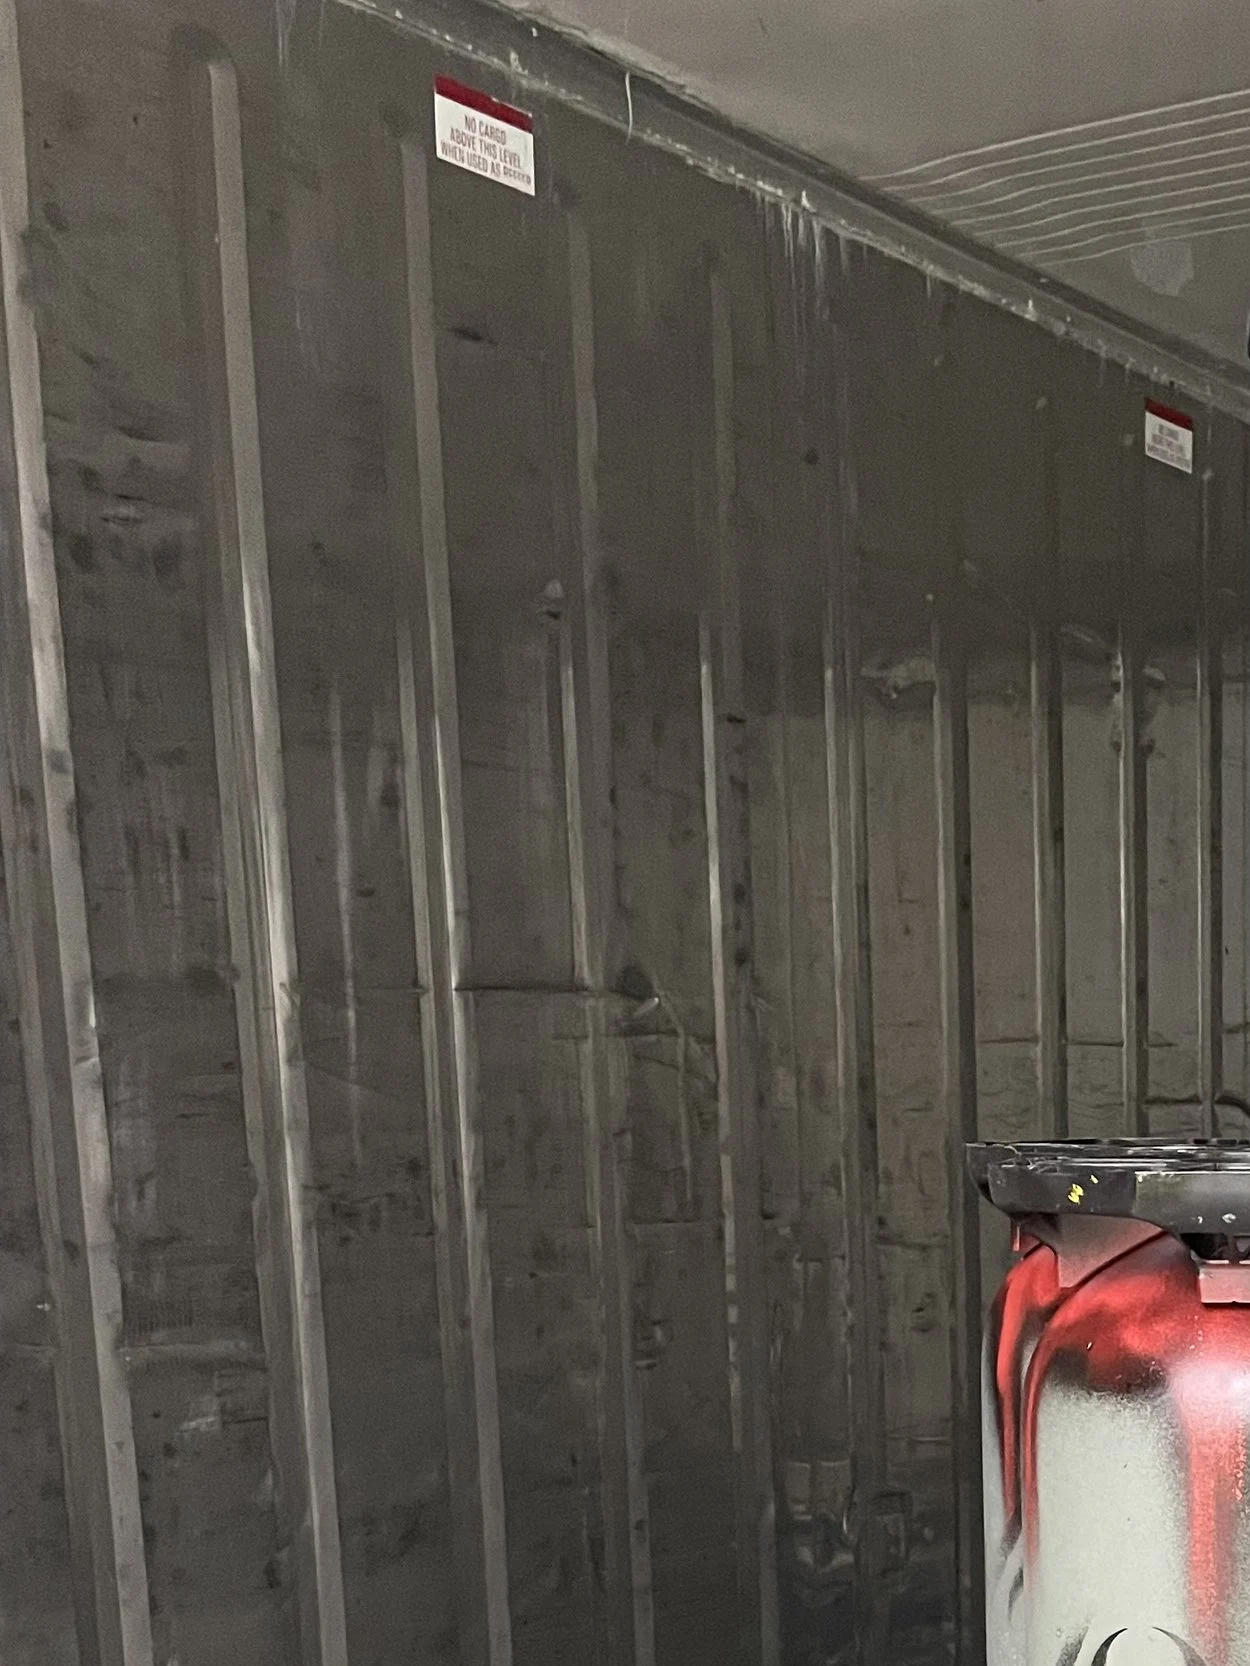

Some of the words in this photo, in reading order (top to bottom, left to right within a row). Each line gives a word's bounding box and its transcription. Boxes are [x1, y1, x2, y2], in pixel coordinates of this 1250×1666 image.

[450, 127, 476, 151] ABOVE
[479, 138, 498, 161] THIS
[499, 146, 522, 170] LEVEL
[465, 115, 477, 133] NO
[479, 120, 506, 145] CARGO
[441, 140, 465, 163] WHEN
[467, 151, 488, 172] USED
[490, 161, 501, 178] AS
